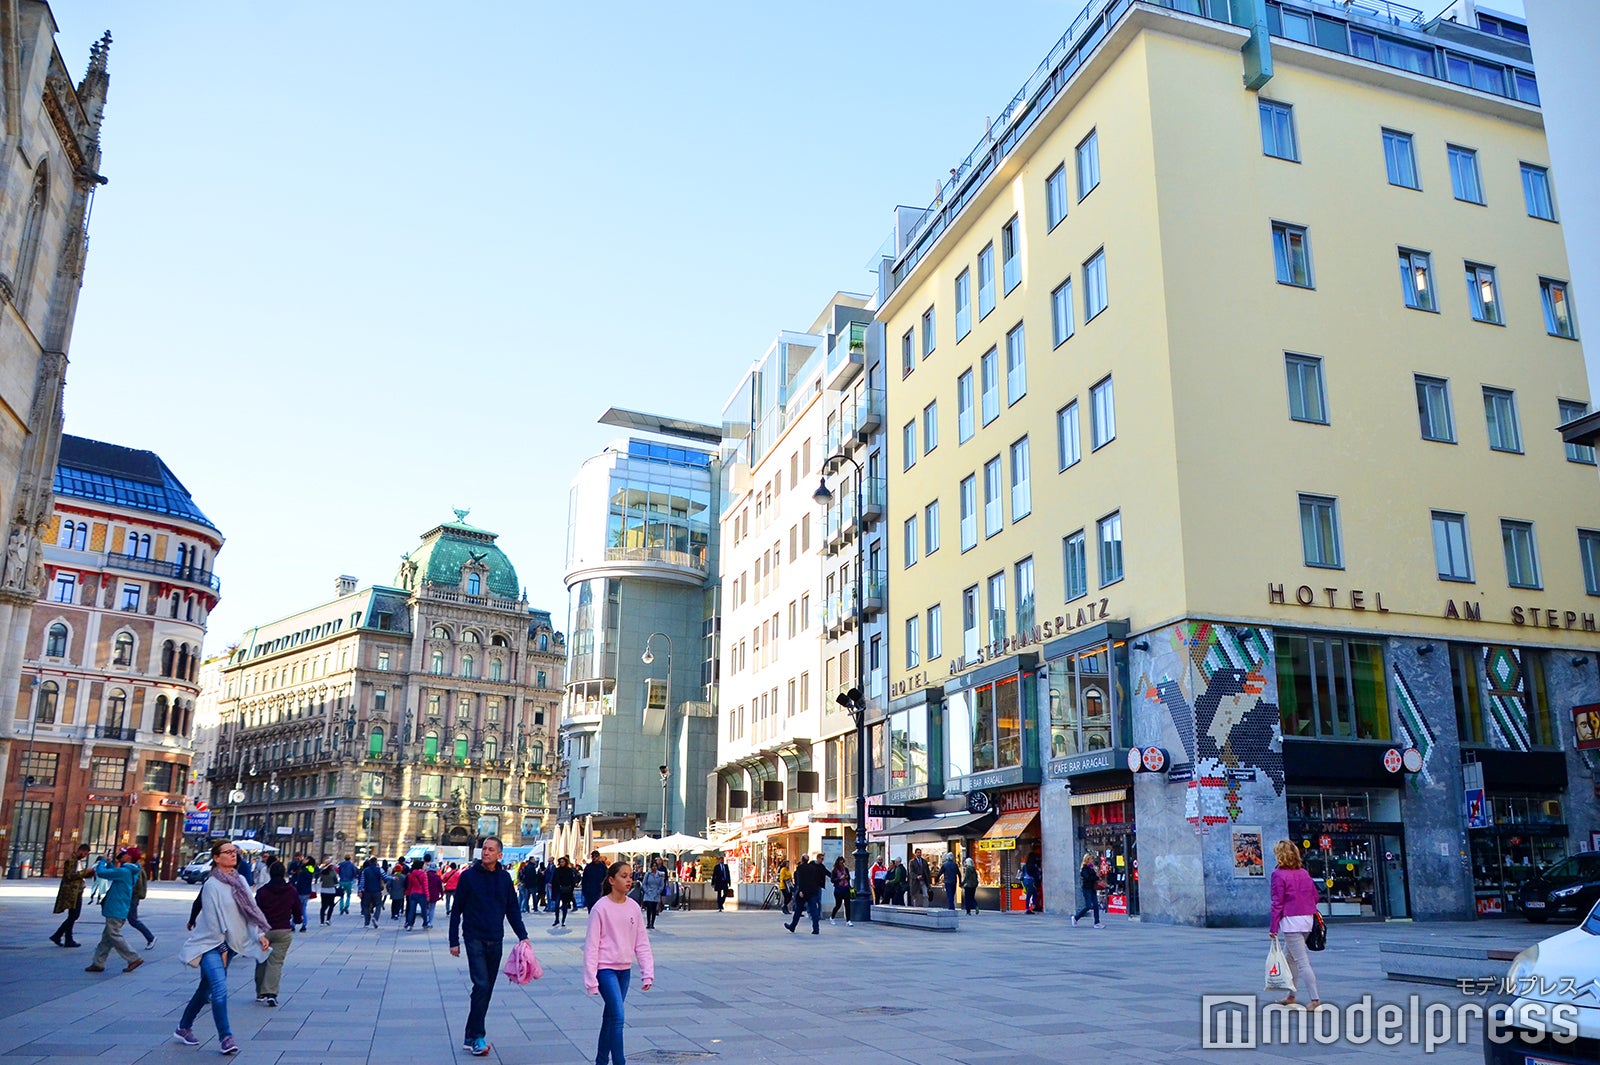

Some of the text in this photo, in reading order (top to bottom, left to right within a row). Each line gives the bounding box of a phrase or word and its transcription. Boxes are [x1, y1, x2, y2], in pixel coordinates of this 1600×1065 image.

[1268, 582, 1595, 632] HOTEL AM STEPH
[891, 597, 1110, 698] HOTEL AM STEPHANSPLATZ
[1053, 756, 1109, 775] CAFE BAR ARAGALL
[1000, 789, 1039, 811] CHANGE
